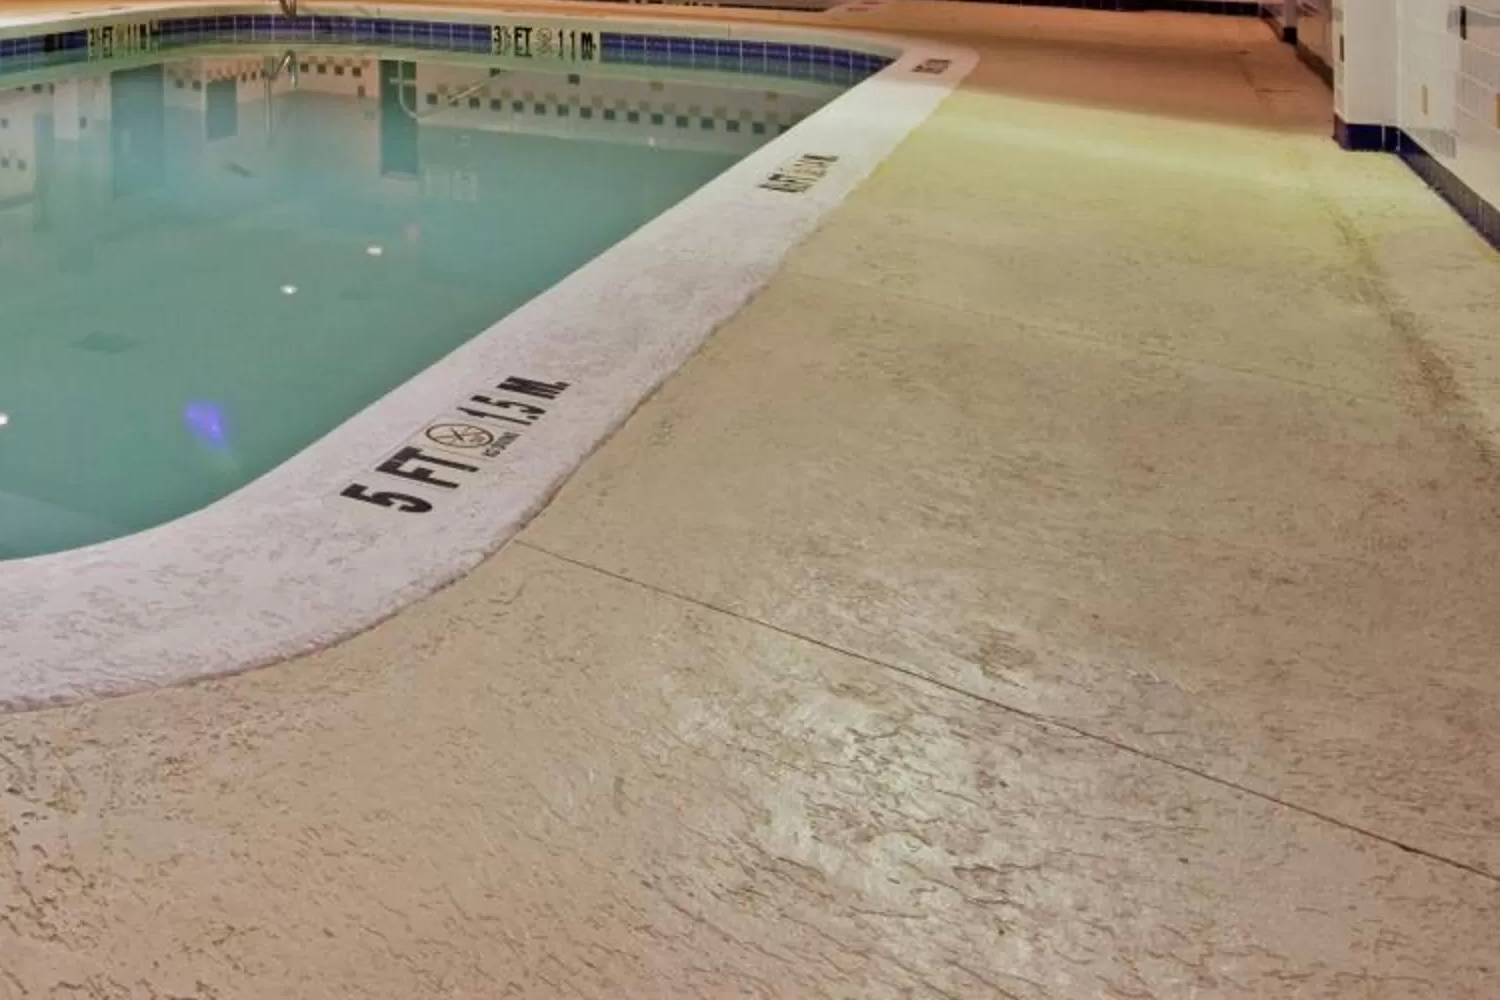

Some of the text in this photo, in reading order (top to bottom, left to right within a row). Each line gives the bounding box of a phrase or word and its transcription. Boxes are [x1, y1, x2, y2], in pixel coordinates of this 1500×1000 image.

[495, 375, 573, 400] M.
[456, 394, 547, 426] 1.5
[374, 445, 480, 490] FT
[339, 482, 434, 514] 5
